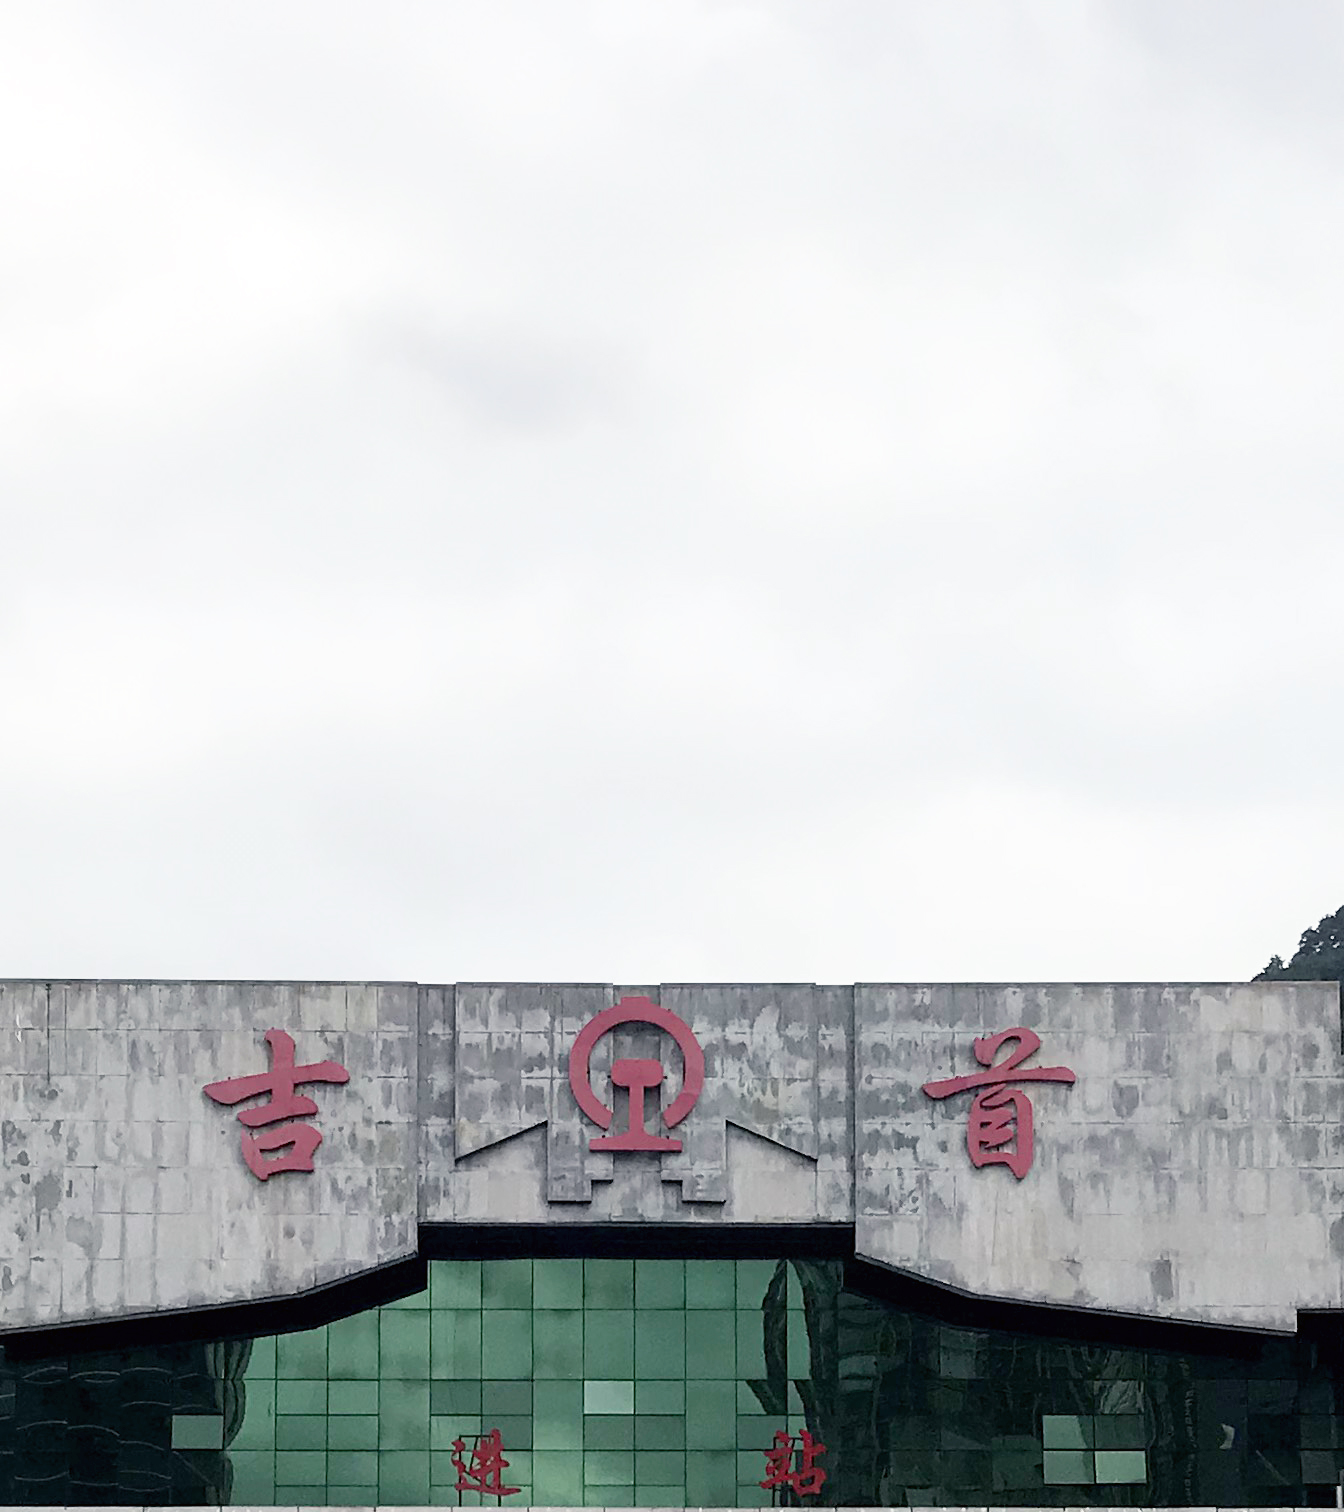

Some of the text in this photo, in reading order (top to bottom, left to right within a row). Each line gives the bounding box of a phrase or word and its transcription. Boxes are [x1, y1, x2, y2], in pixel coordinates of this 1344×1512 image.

[203, 1027, 1077, 1182] 吉 首
[451, 1428, 827, 1497] 进 站
